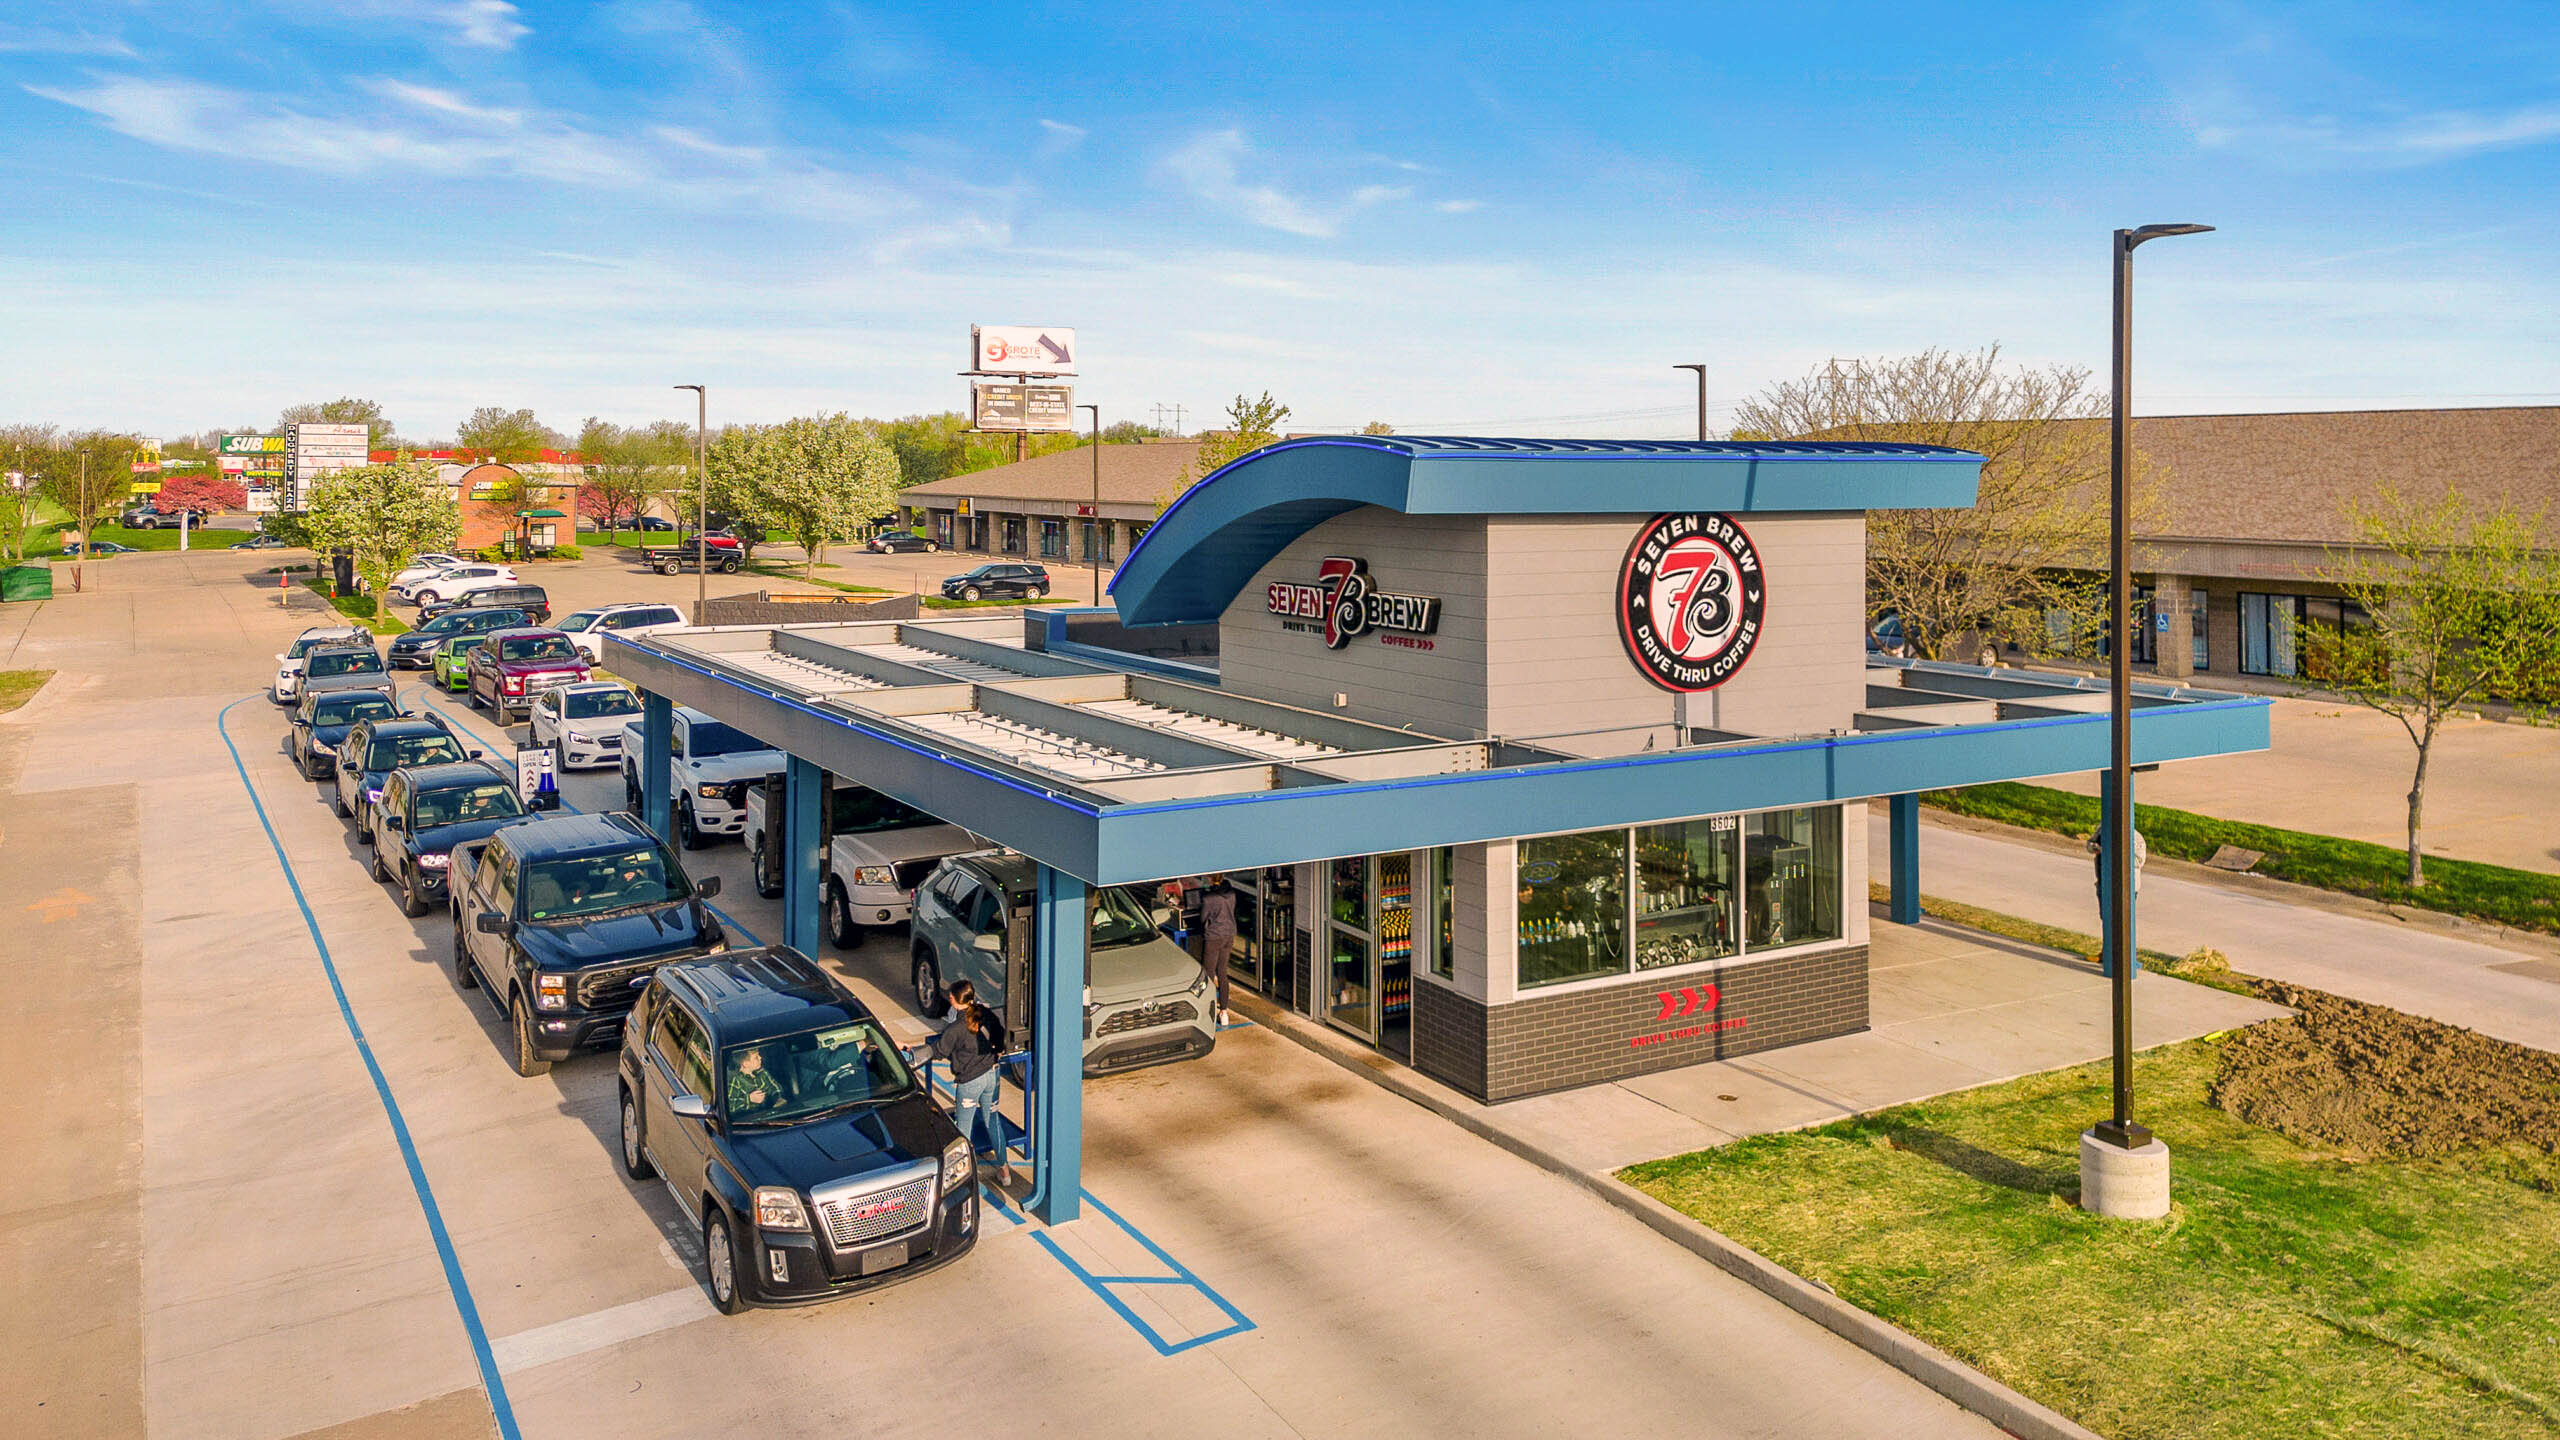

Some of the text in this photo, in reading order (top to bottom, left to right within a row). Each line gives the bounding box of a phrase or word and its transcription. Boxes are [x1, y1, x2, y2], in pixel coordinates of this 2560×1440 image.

[1007, 345, 1040, 355] GROTE
[226, 437, 285, 452] SUBWA
[286, 425, 296, 509] DAUGHERTY PLAZA
[1638, 515, 1757, 576] SEVEN BREW
[1267, 582, 1325, 619] SEVEN
[1368, 592, 1432, 632] BREW
[1283, 621, 1306, 632] DRIVE
[1381, 634, 1415, 648] COFFEE
[1637, 619, 1756, 682] DRIVE THRU COFFEE
[1711, 816, 1735, 830] 3602
[1630, 1017, 1748, 1048] DRIVE THRU COFFEE
[858, 1196, 905, 1218] GMC
